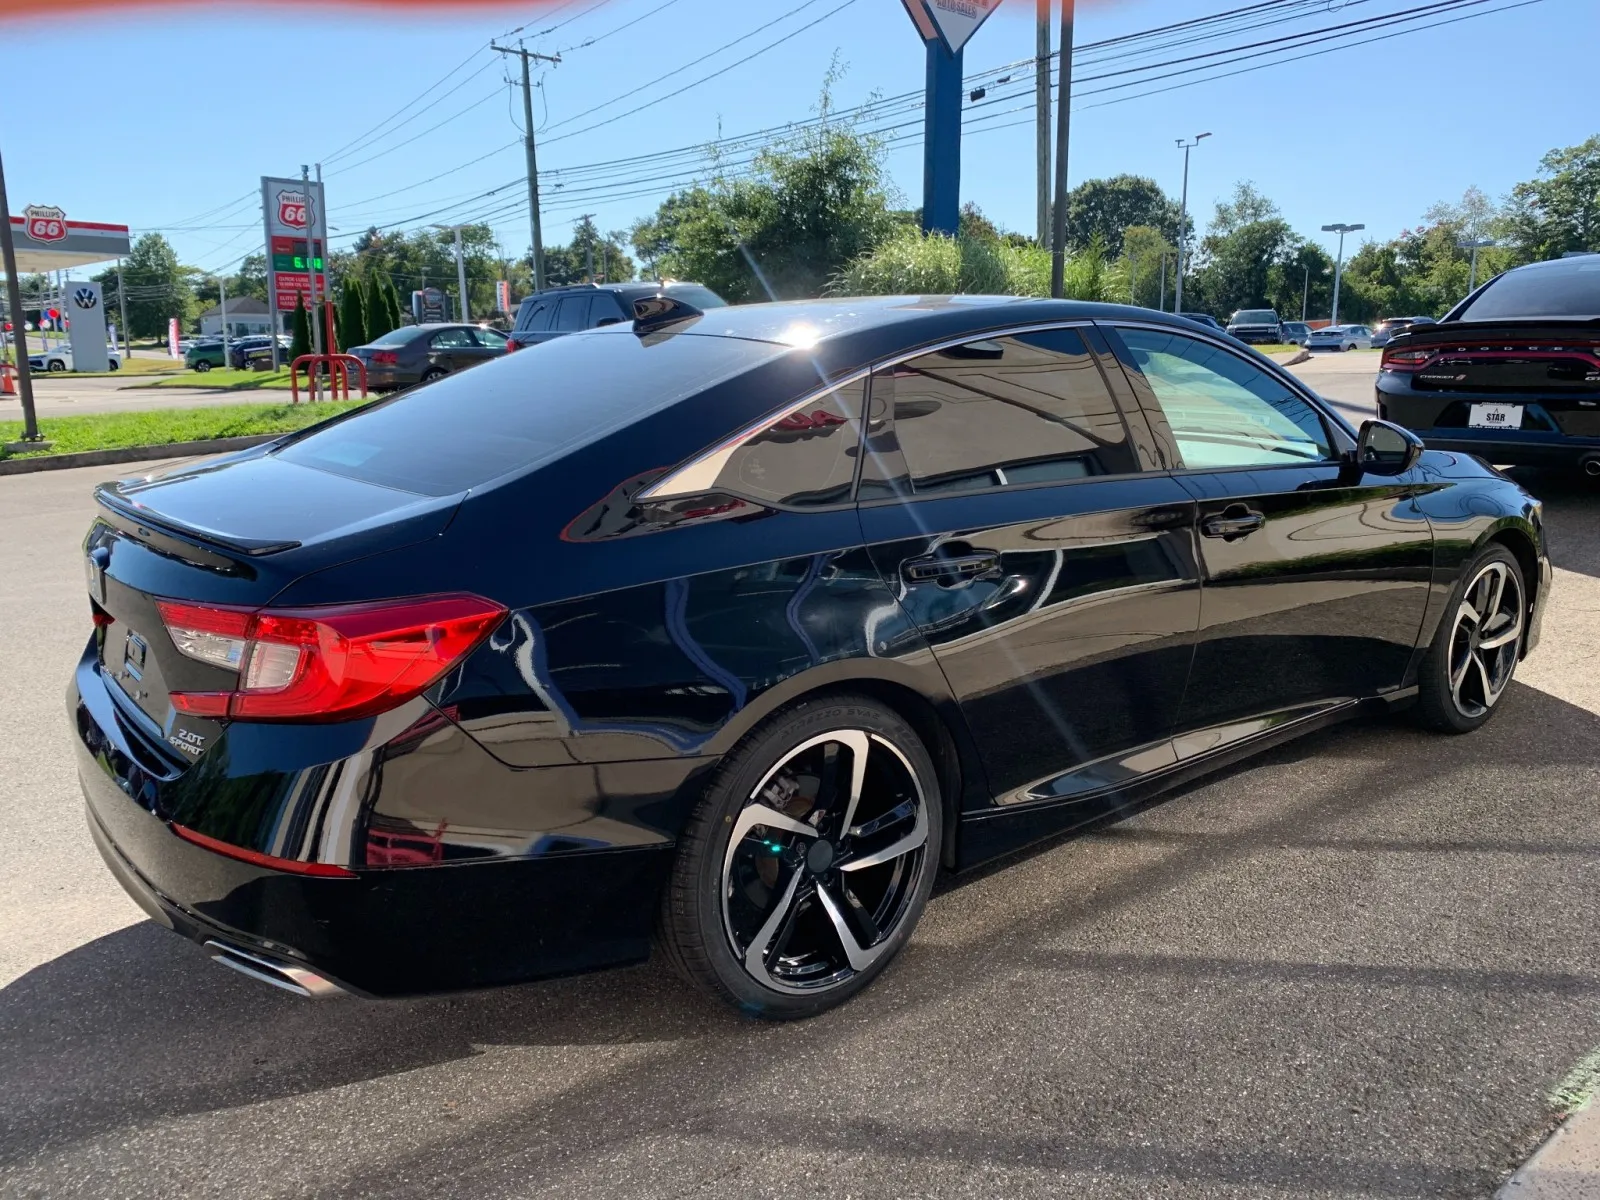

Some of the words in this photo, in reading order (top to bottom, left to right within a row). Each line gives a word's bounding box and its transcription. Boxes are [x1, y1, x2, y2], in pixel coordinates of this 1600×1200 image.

[957, 2, 977, 17] SALES
[281, 193, 306, 204] PHILLIP
[30, 210, 60, 219] PHILLIPS
[34, 220, 61, 236] 66
[1486, 412, 1506, 422] STAR
[178, 728, 206, 746] 2.0T
[168, 735, 205, 755] SPORT
